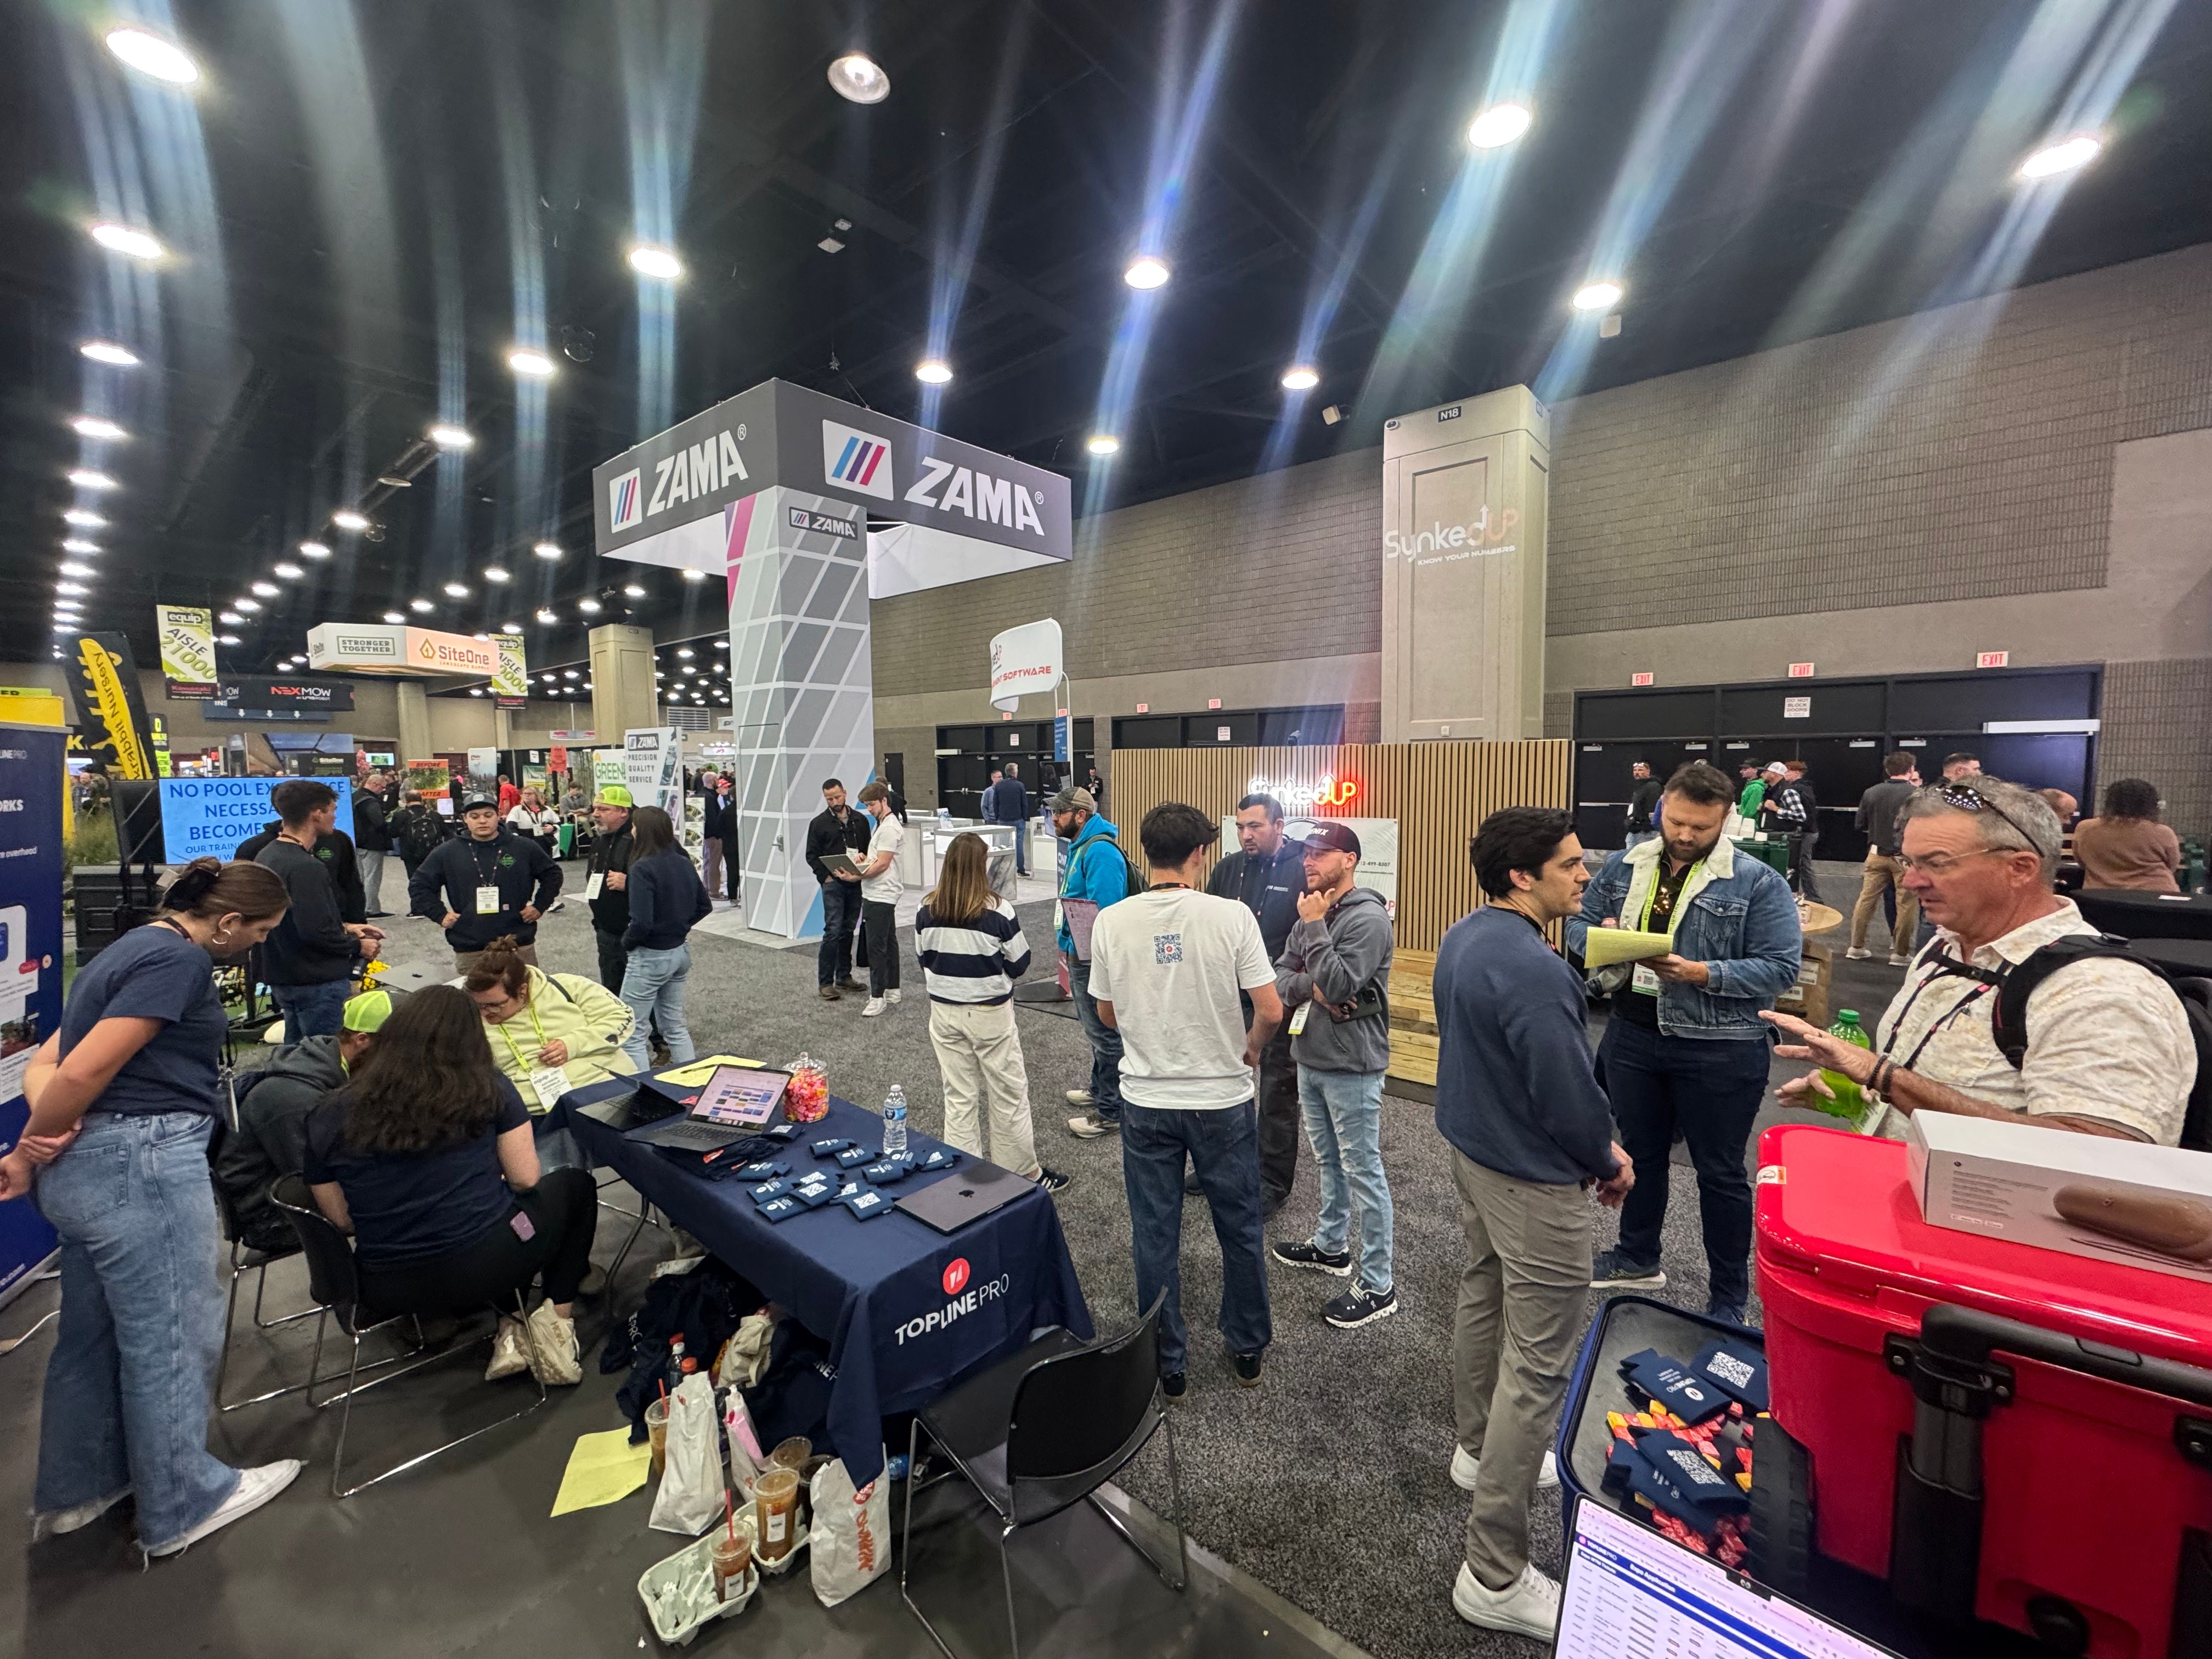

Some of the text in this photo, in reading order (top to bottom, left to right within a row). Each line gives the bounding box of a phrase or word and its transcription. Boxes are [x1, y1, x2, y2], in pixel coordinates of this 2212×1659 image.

[1440, 408, 1459, 421] N18
[646, 430, 749, 517] ZAMA
[904, 456, 1046, 536] ZAMA
[811, 516, 856, 538] ZAMA
[1418, 545, 1516, 566] KNOW YOUR NUMBERS
[169, 613, 202, 624] equip
[167, 628, 207, 656] AISLE
[498, 640, 518, 648] quip
[161, 635, 217, 679] 21000
[439, 646, 489, 665] SiteOne
[1982, 654, 2004, 666] EXIT
[1003, 665, 1052, 682] SOFTWARE
[1793, 665, 1811, 676] EXIT
[94, 652, 120, 719] Nursery
[1635, 674, 1651, 685] EXIT
[637, 736, 658, 748] ZAMA
[595, 763, 626, 780] GREEN
[170, 784, 199, 798] NO
[204, 783, 251, 797] POOL
[205, 803, 278, 819] NECESSA
[185, 845, 206, 854] OUR
